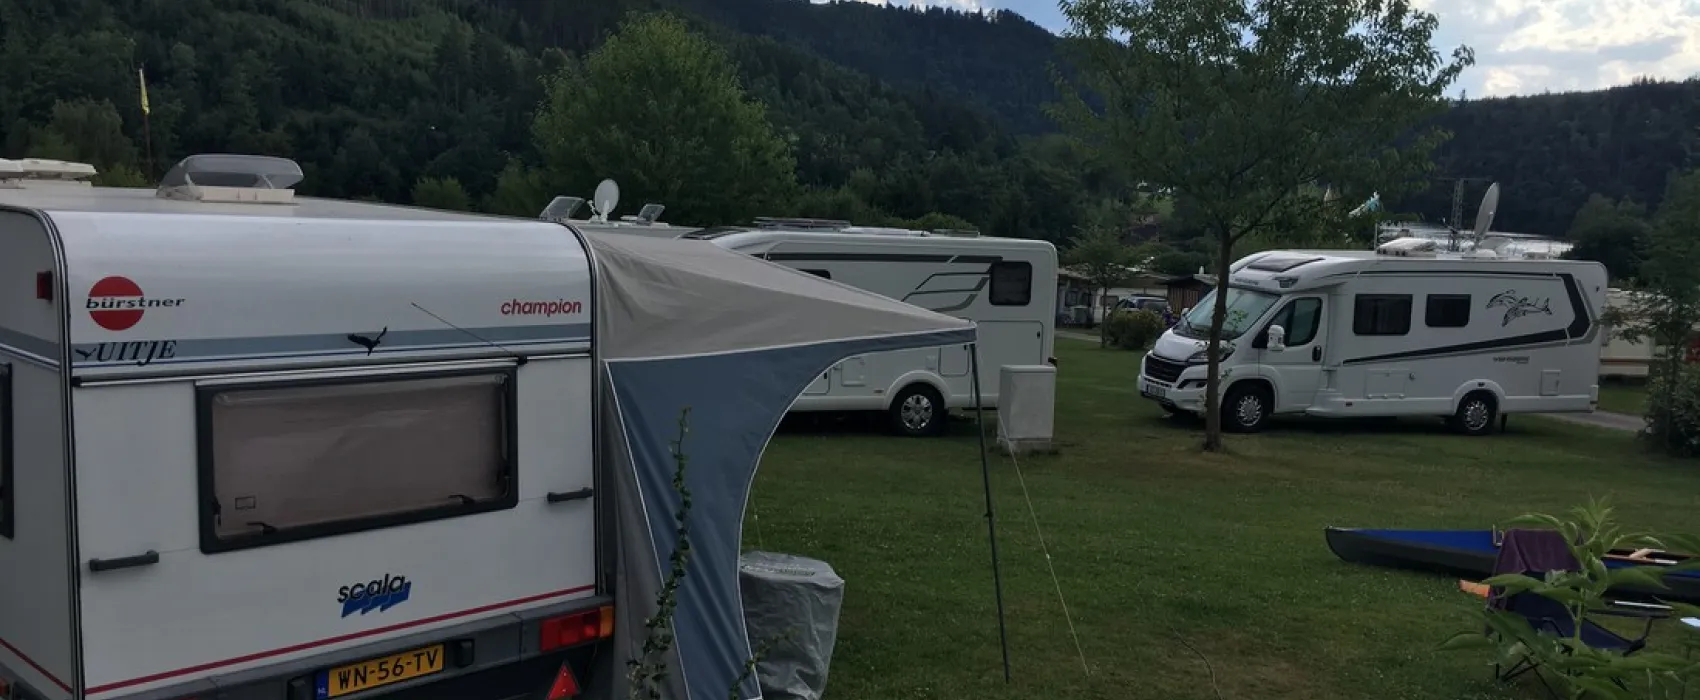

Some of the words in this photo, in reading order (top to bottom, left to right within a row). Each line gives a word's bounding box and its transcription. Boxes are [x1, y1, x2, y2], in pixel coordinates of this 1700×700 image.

[86, 297, 186, 309] bürstner
[501, 299, 582, 317] champion
[96, 340, 177, 367] UITJE
[337, 573, 406, 603] scala
[337, 647, 439, 690] WN-56-TV
